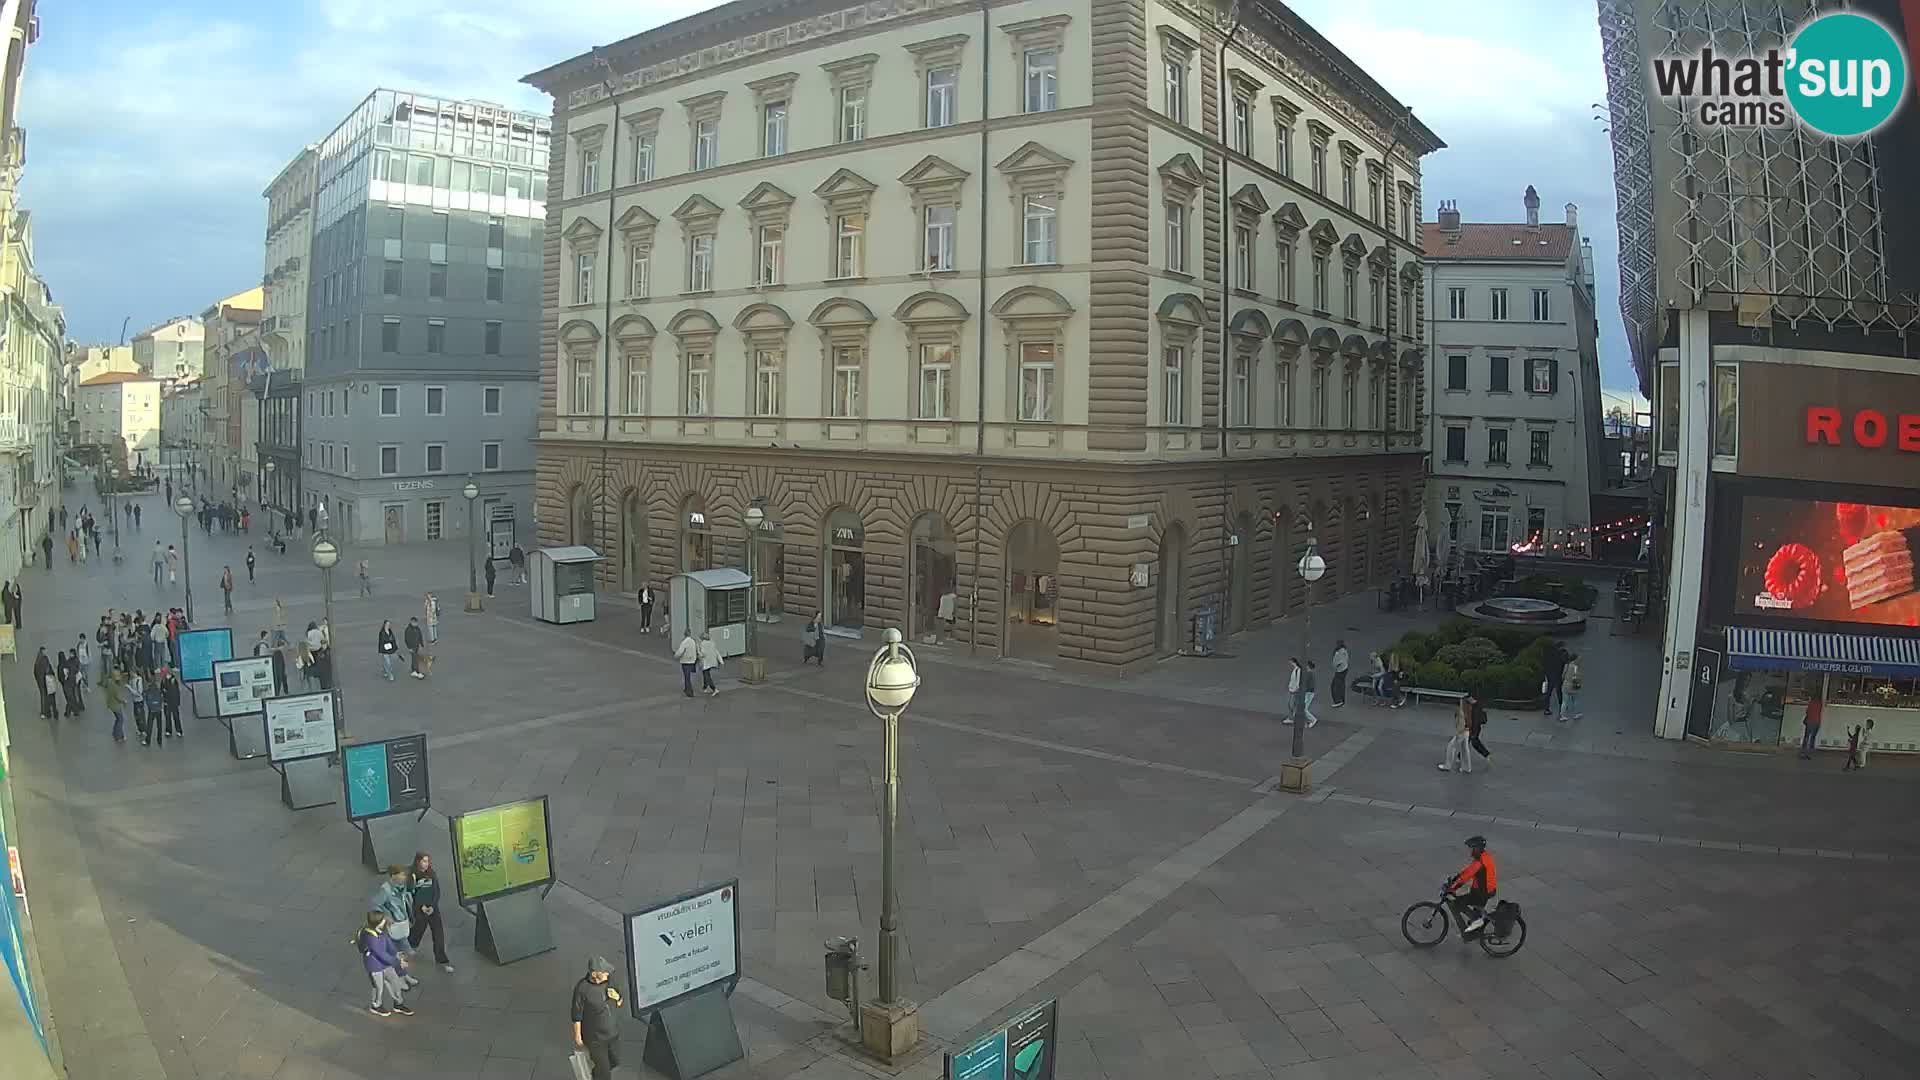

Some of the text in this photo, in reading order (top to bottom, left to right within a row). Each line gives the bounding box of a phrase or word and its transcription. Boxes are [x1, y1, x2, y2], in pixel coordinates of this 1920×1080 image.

[391, 479, 433, 490] TEZENIS
[1701, 665, 1710, 681] a
[680, 919, 713, 941] veleri
